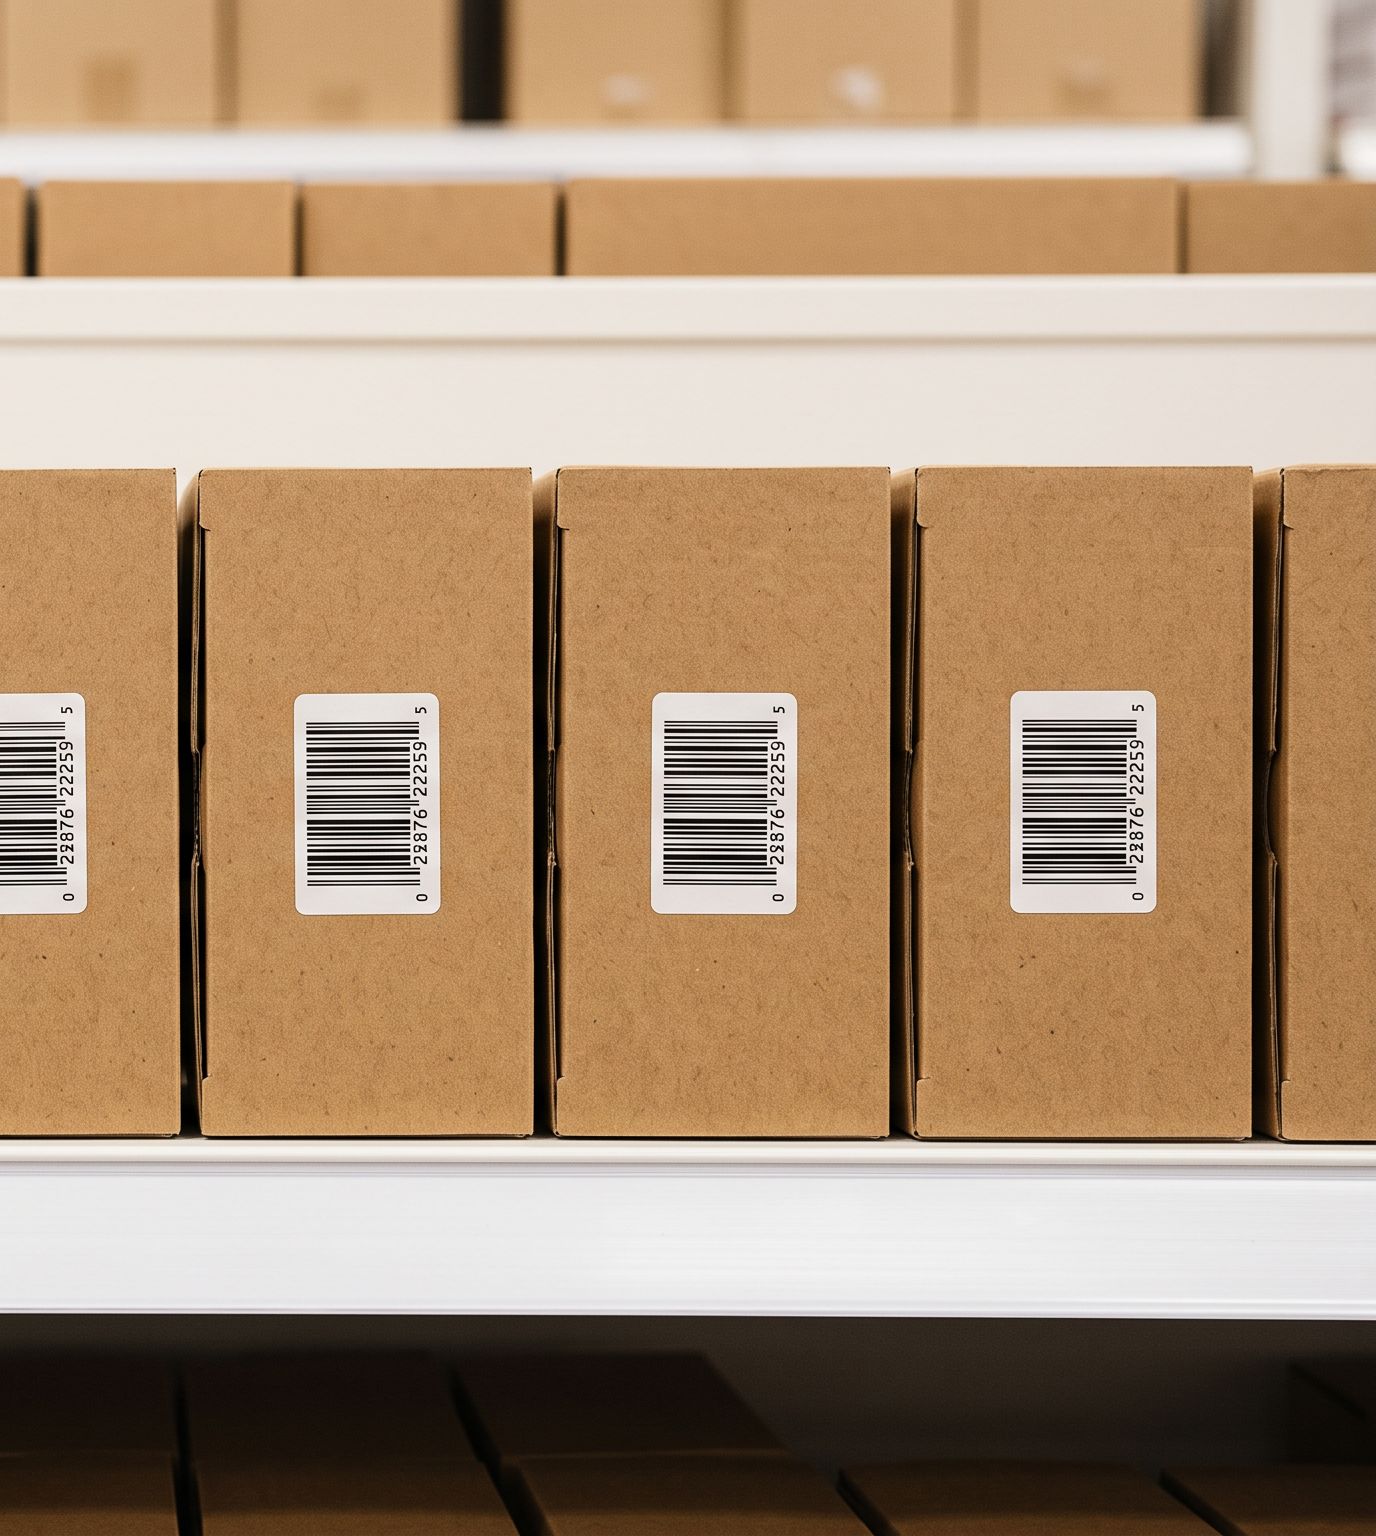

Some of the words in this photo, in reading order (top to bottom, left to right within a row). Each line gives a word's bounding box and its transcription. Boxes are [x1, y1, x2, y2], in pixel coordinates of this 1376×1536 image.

[60, 706, 73, 714] 5
[414, 706, 428, 714] 5
[772, 706, 786, 714] 5
[1131, 704, 1145, 712] 5
[58, 741, 74, 797] 22259
[412, 741, 428, 797] 22259
[770, 741, 786, 797] 22259
[1129, 739, 1145, 796] 22259
[62, 893, 75, 902] 0
[415, 893, 428, 902] 0
[772, 893, 785, 902] 0
[1131, 892, 1144, 901] 0
